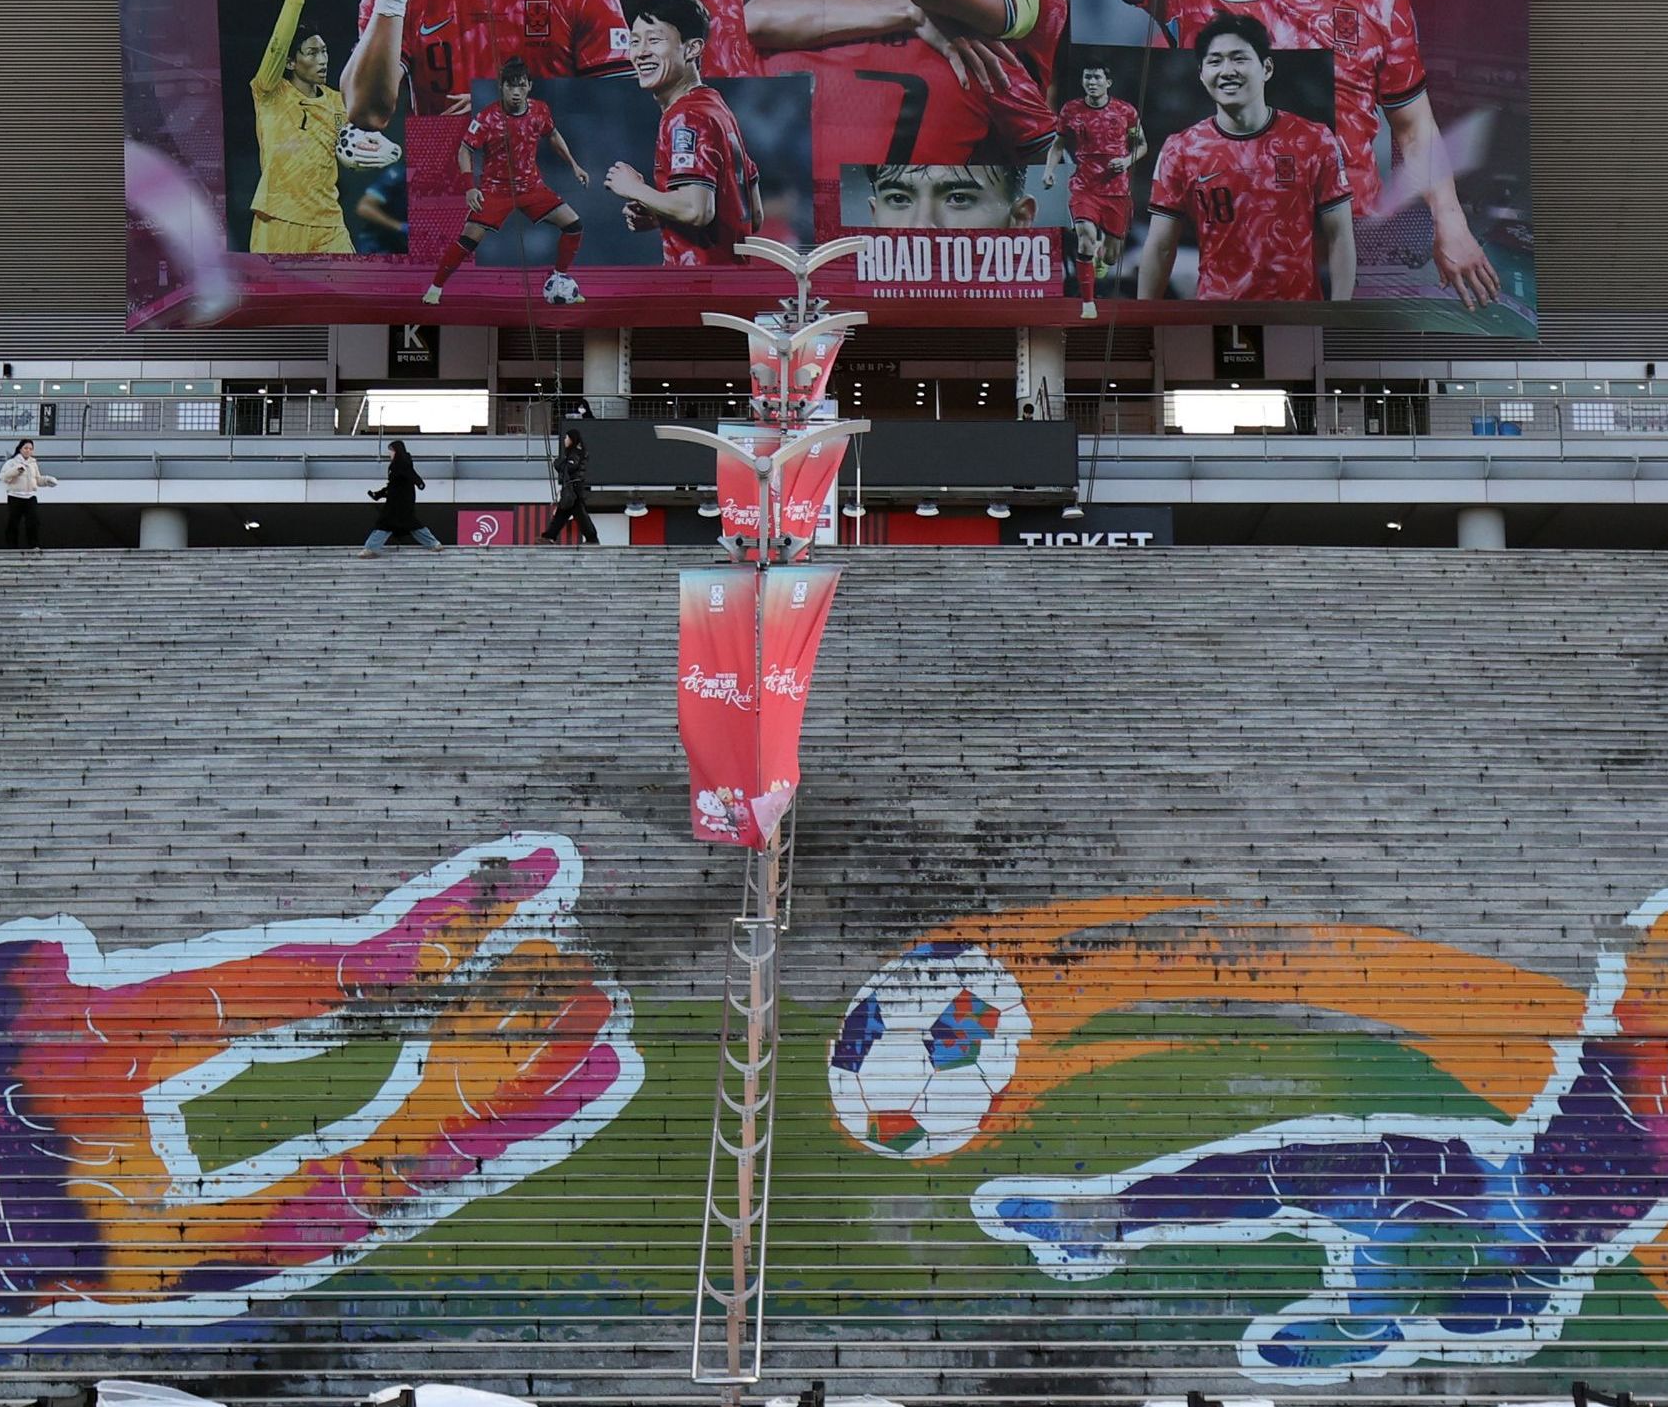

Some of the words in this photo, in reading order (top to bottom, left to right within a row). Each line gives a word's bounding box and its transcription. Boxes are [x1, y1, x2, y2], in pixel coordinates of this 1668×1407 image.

[426, 41, 454, 94] 9
[299, 109, 308, 131] 1
[854, 69, 929, 165] 7
[1195, 187, 1235, 225] 18
[857, 235, 932, 282] ROAD
[935, 235, 973, 282] TO
[976, 235, 1051, 282] 2026
[873, 288, 905, 299] KOREA
[909, 288, 958, 299] NATIONAL
[963, 288, 1013, 299] FOOTBALL
[1018, 288, 1044, 299] TEAM
[404, 324, 424, 348] K
[1232, 325, 1247, 349] L
